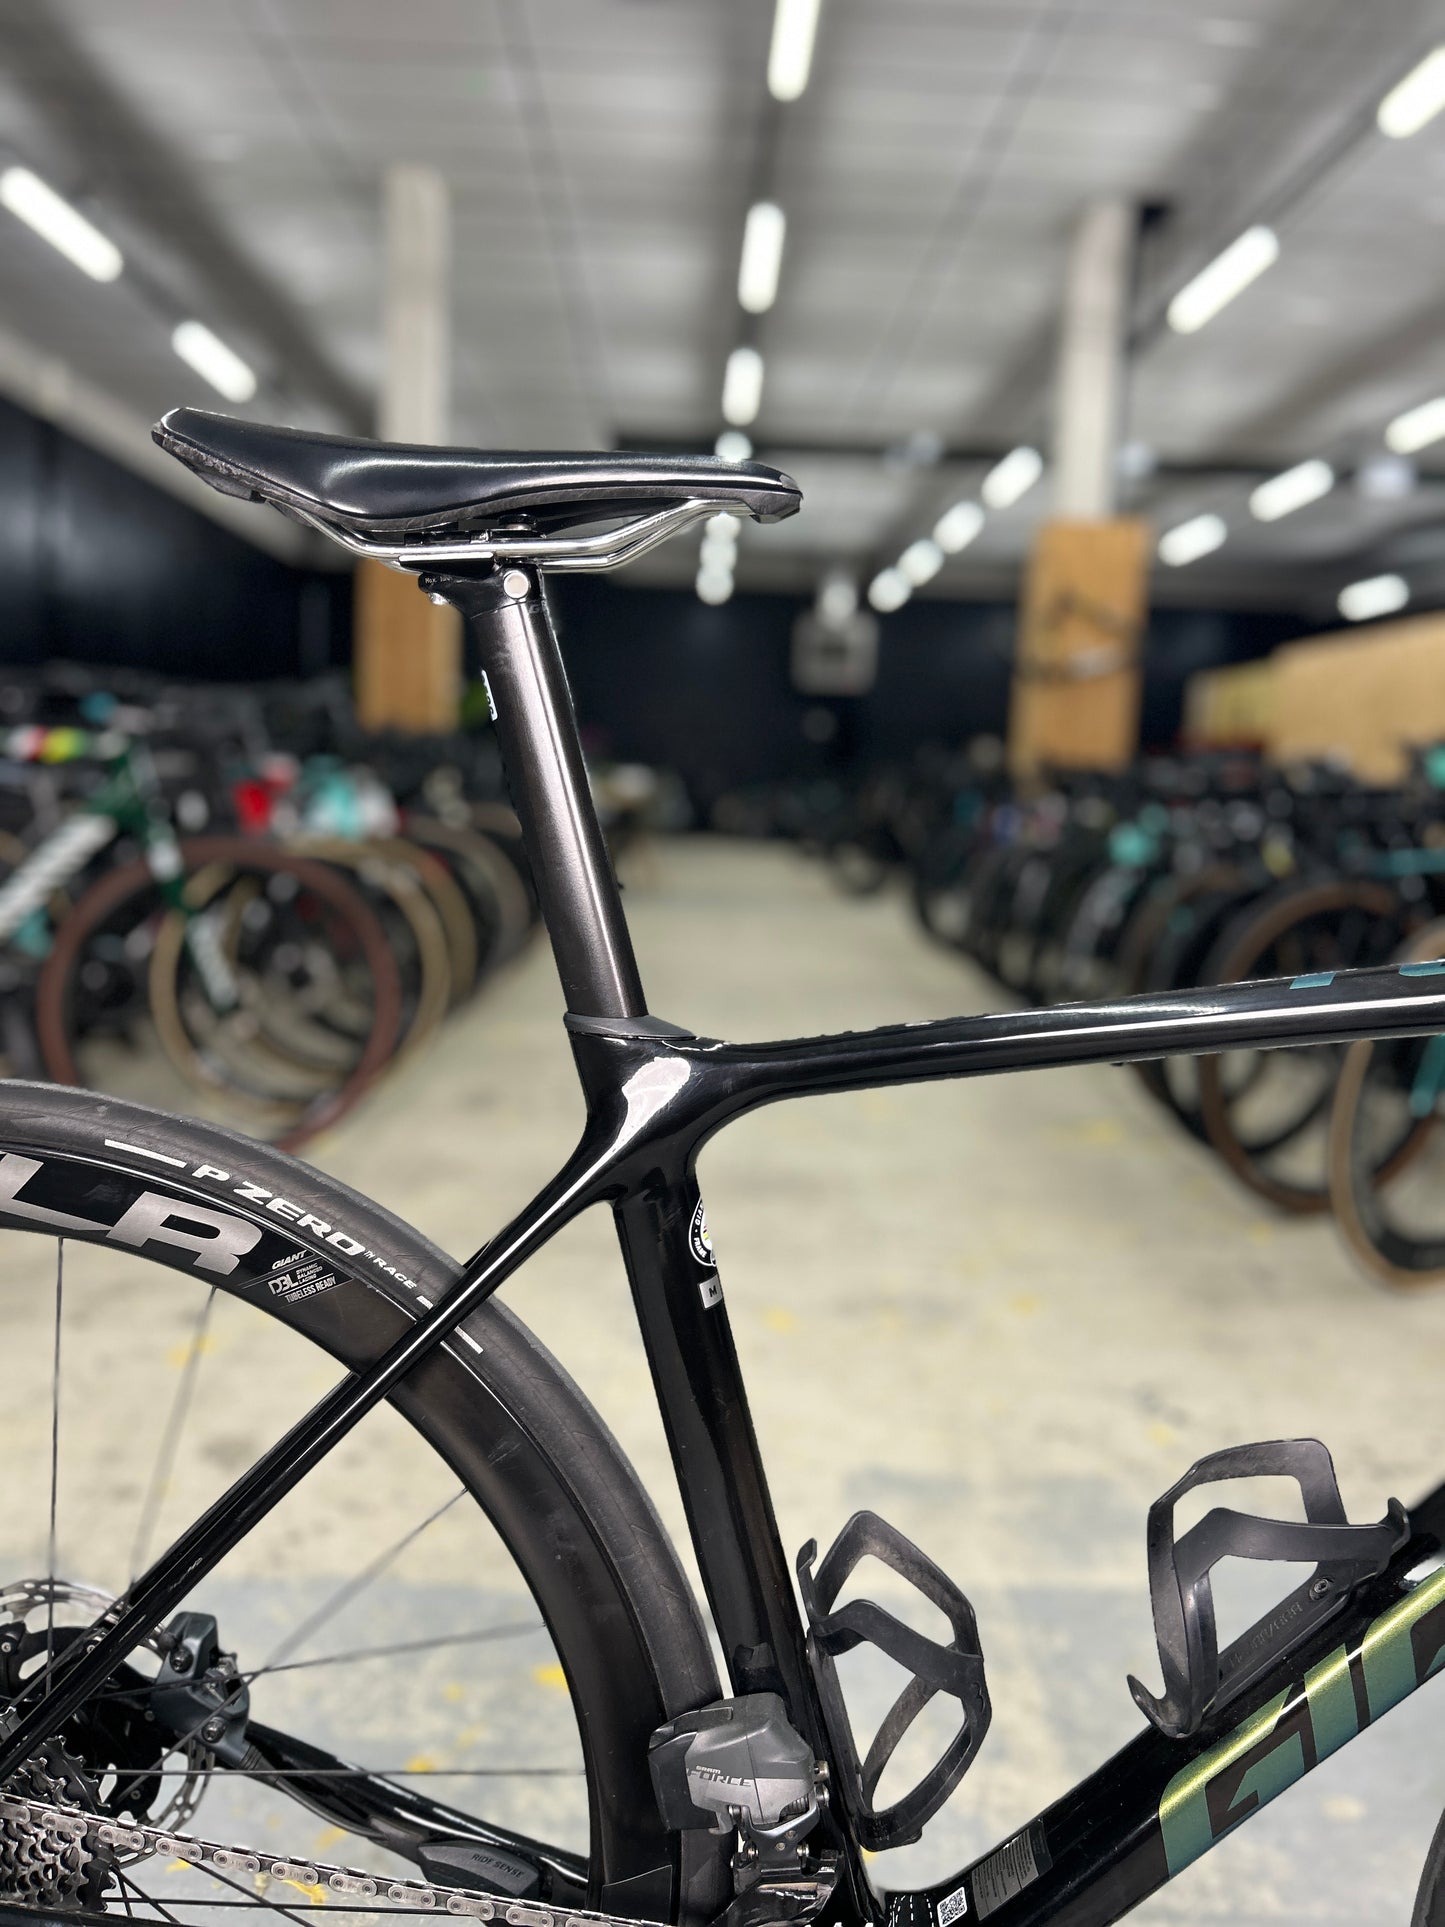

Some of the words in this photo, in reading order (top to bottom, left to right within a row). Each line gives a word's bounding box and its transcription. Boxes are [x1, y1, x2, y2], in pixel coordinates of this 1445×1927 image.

[191, 1164, 231, 1182] P
[233, 1181, 367, 1256] ZERO
[372, 1257, 417, 1289] RACE
[271, 1249, 308, 1270] GIANT
[284, 1284, 317, 1303] TUBELESS
[315, 1276, 337, 1292] READY
[708, 1285, 718, 1298] M
[687, 1769, 751, 1787] FORCE
[471, 1853, 495, 1867] RIDE
[495, 1860, 525, 1879] SENSE
